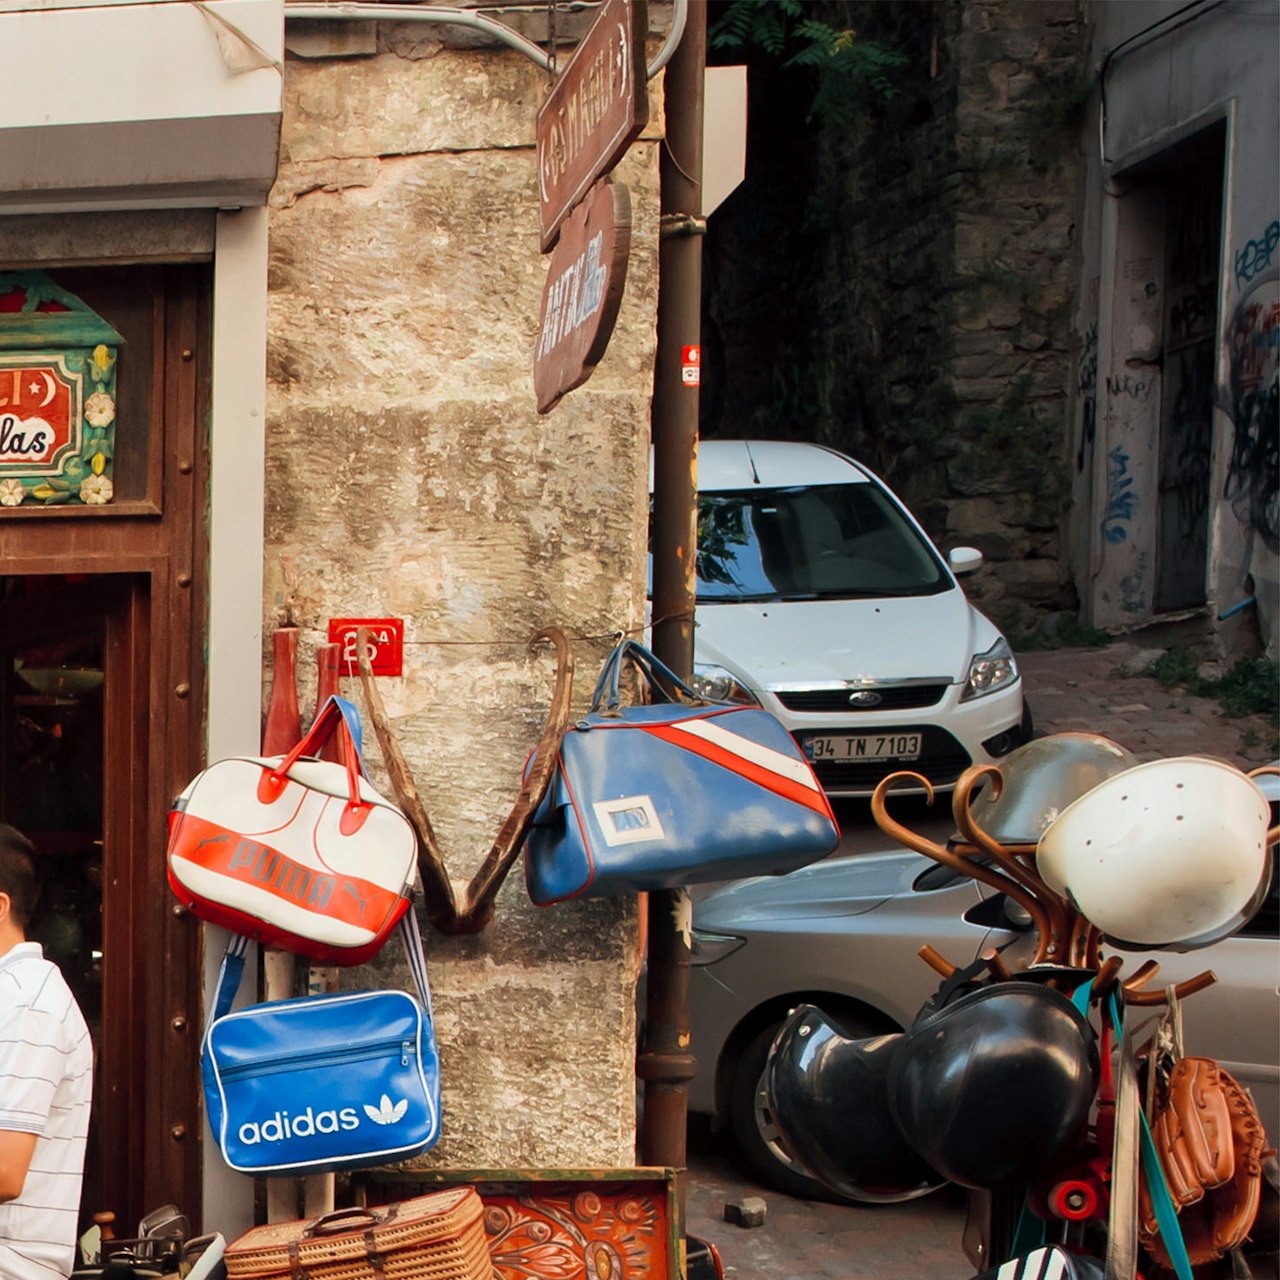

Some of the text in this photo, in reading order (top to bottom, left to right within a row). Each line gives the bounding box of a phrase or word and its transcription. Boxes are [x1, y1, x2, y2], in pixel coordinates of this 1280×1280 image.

[814, 736, 919, 757] 34 TN 7103
[227, 840, 337, 908] PUMA
[238, 1106, 360, 1146] adidas
